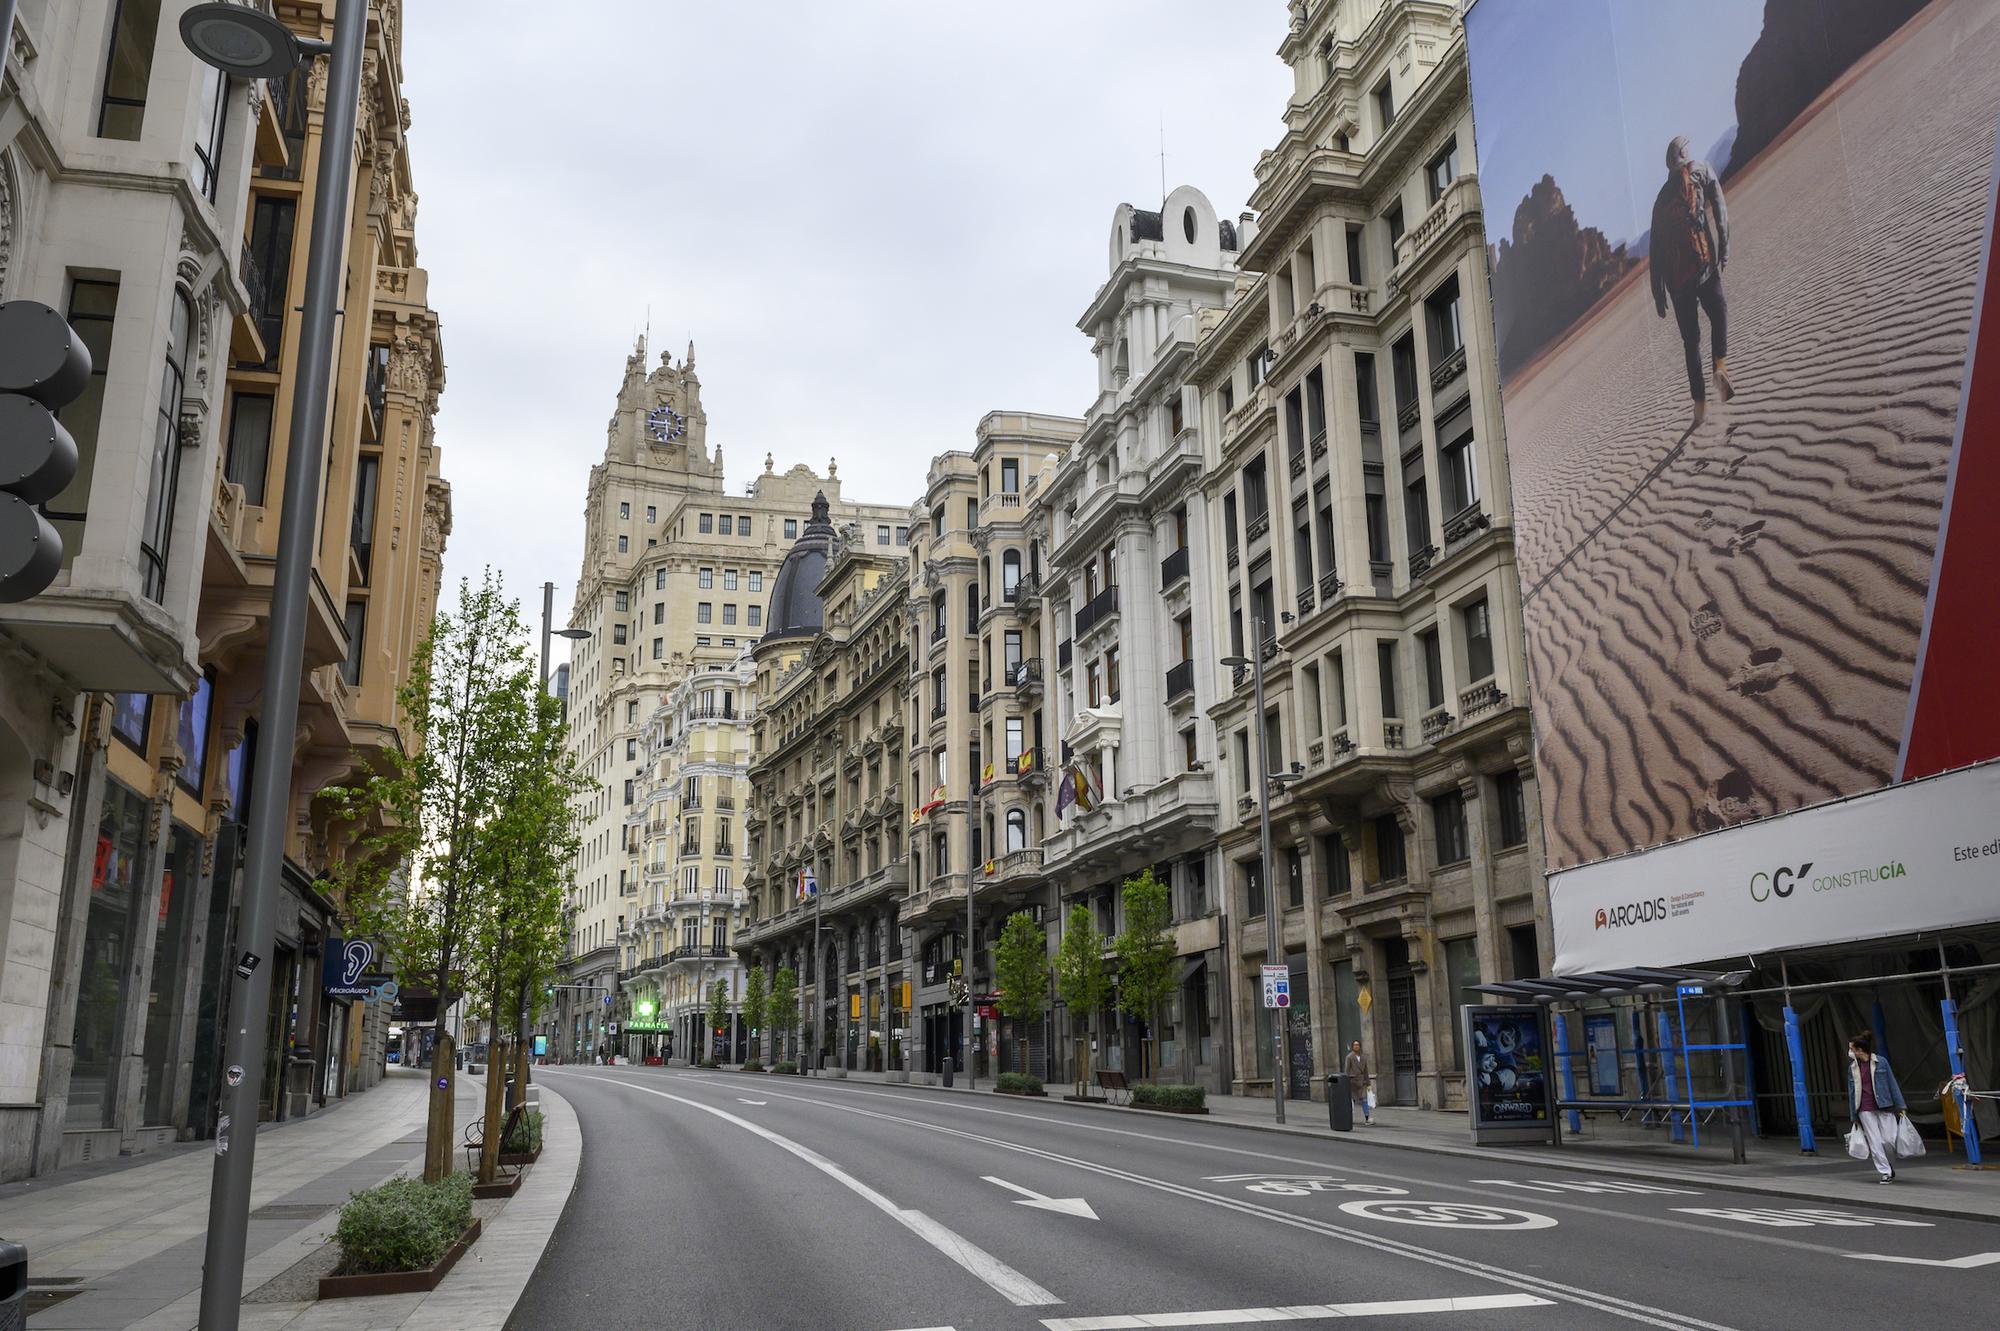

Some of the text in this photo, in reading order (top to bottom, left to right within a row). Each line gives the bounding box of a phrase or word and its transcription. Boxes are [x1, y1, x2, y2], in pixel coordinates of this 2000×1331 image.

[1953, 846, 1979, 862] Este
[1812, 861, 1907, 892] CONSTRUCÍA
[1608, 897, 1667, 930] ARCADIS
[629, 1021, 669, 1029] FARMACIA
[1493, 1102, 1533, 1114] ONWARD
[1381, 1206, 1506, 1222] 30
[1667, 1208, 1937, 1227] BUS
